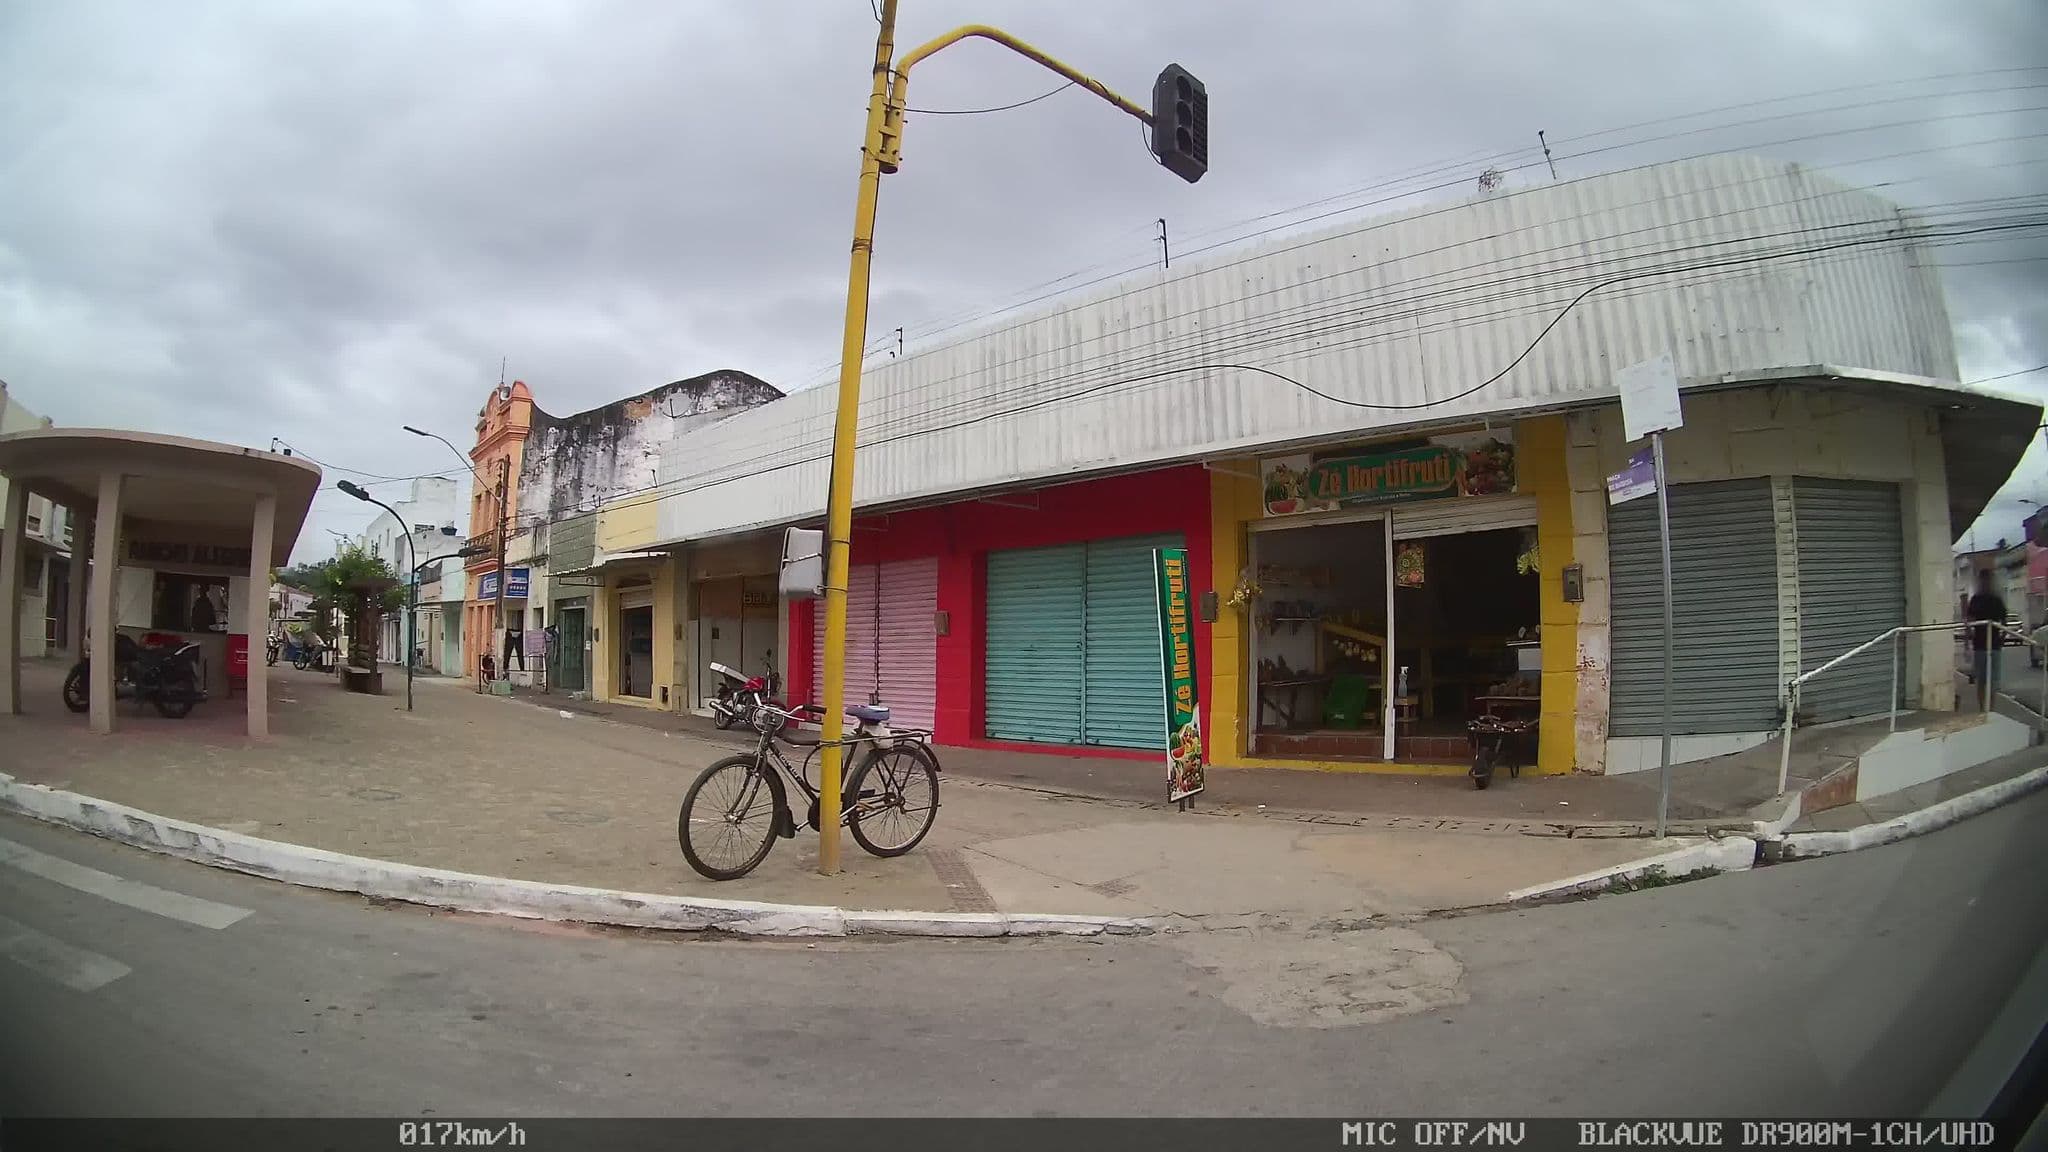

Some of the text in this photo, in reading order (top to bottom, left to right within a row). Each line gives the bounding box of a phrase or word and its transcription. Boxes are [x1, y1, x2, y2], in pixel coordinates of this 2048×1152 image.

[1318, 453, 1450, 497] Zé Hortifruti
[1165, 559, 1193, 716] Zé Hortifruti
